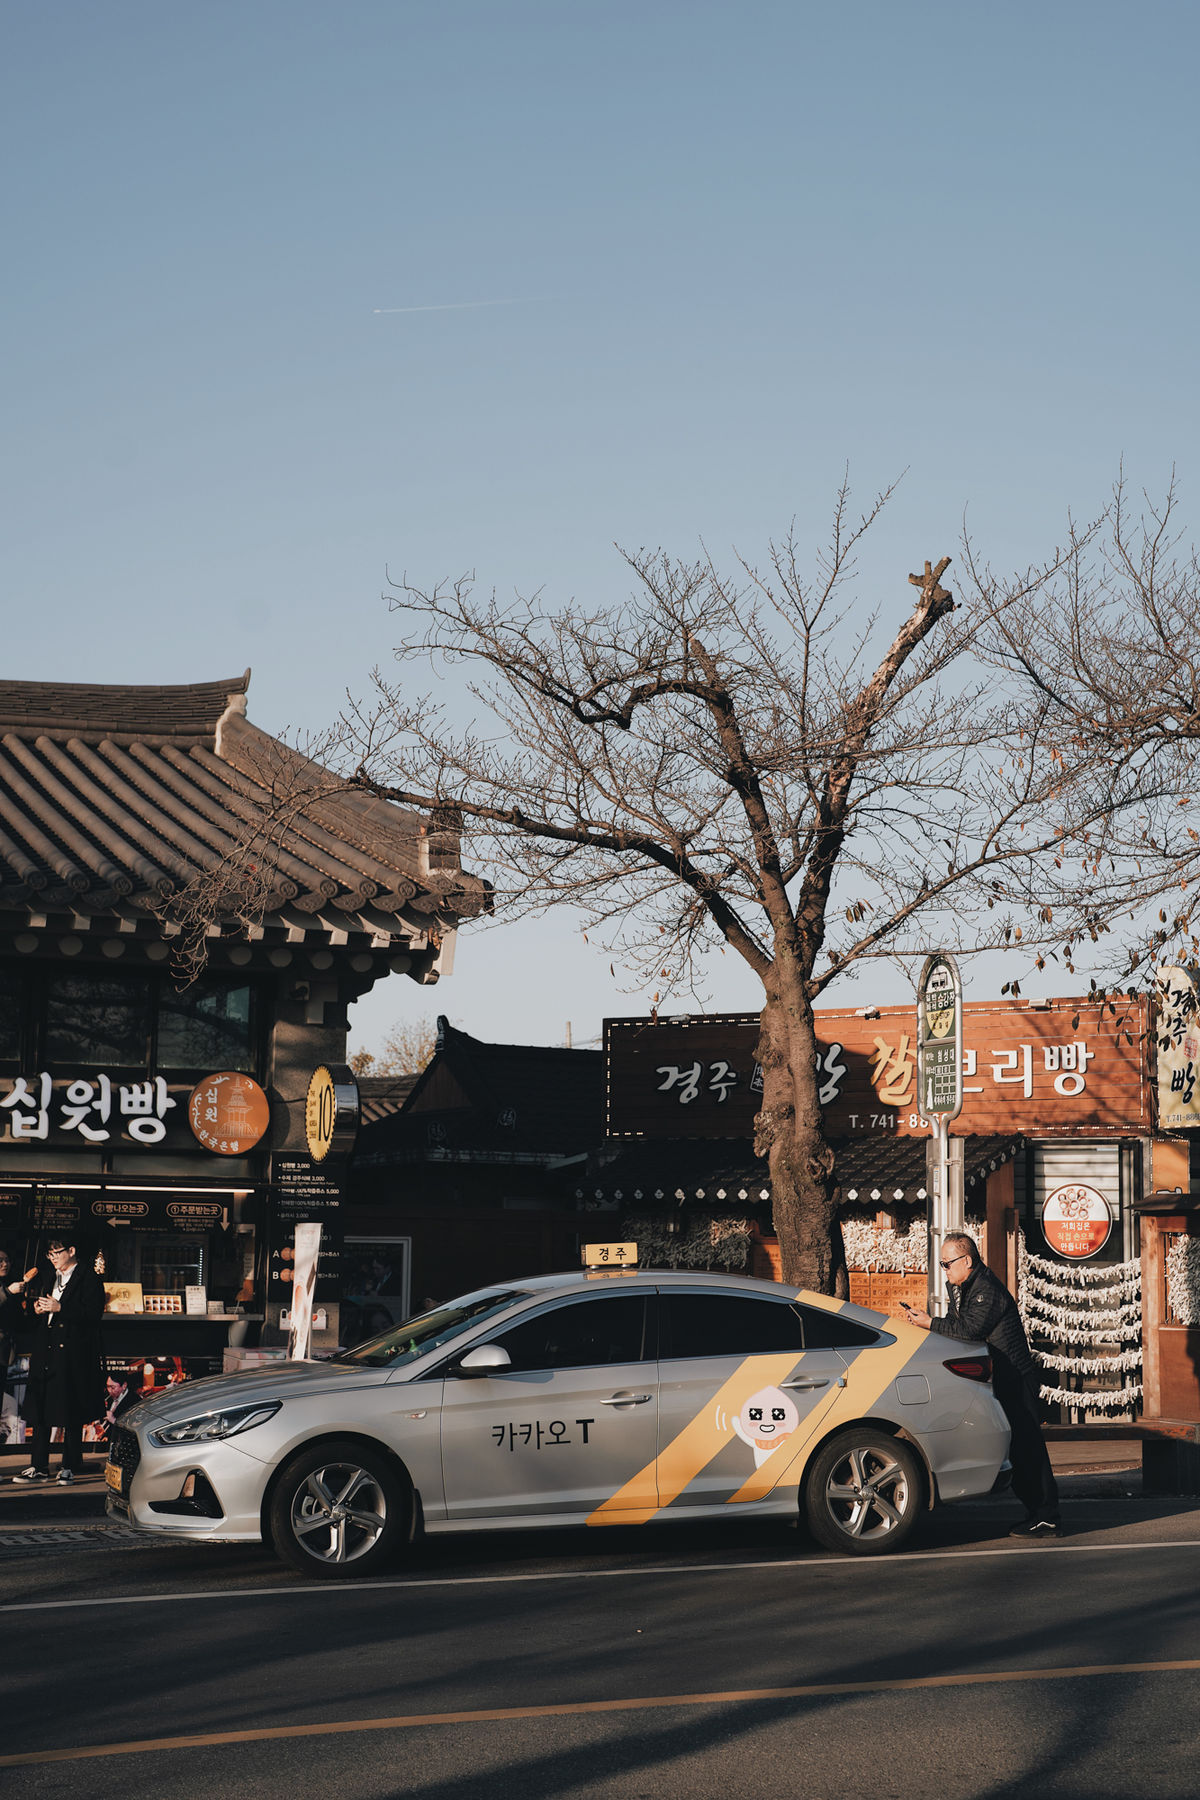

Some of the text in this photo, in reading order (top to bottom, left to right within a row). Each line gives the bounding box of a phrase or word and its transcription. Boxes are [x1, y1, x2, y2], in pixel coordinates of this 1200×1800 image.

[937, 1048, 955, 1063] 첨성대
[656, 1060, 737, 1104] 경주
[1171, 1061, 1196, 1104] 빵
[0, 1071, 177, 1143] 십원빵
[205, 1087, 218, 1123] 십원
[318, 1084, 333, 1142] 10
[199, 1129, 240, 1152] 한국은행
[106, 1204, 145, 1214] 빵나오는곳
[180, 1205, 218, 1215] 주문받는곳
[1060, 1221, 1092, 1231] 저희집은
[1057, 1232, 1095, 1241] 직접 손으로
[272, 1250, 280, 1258] A
[598, 1247, 627, 1262] 경주
[272, 1271, 280, 1280] B
